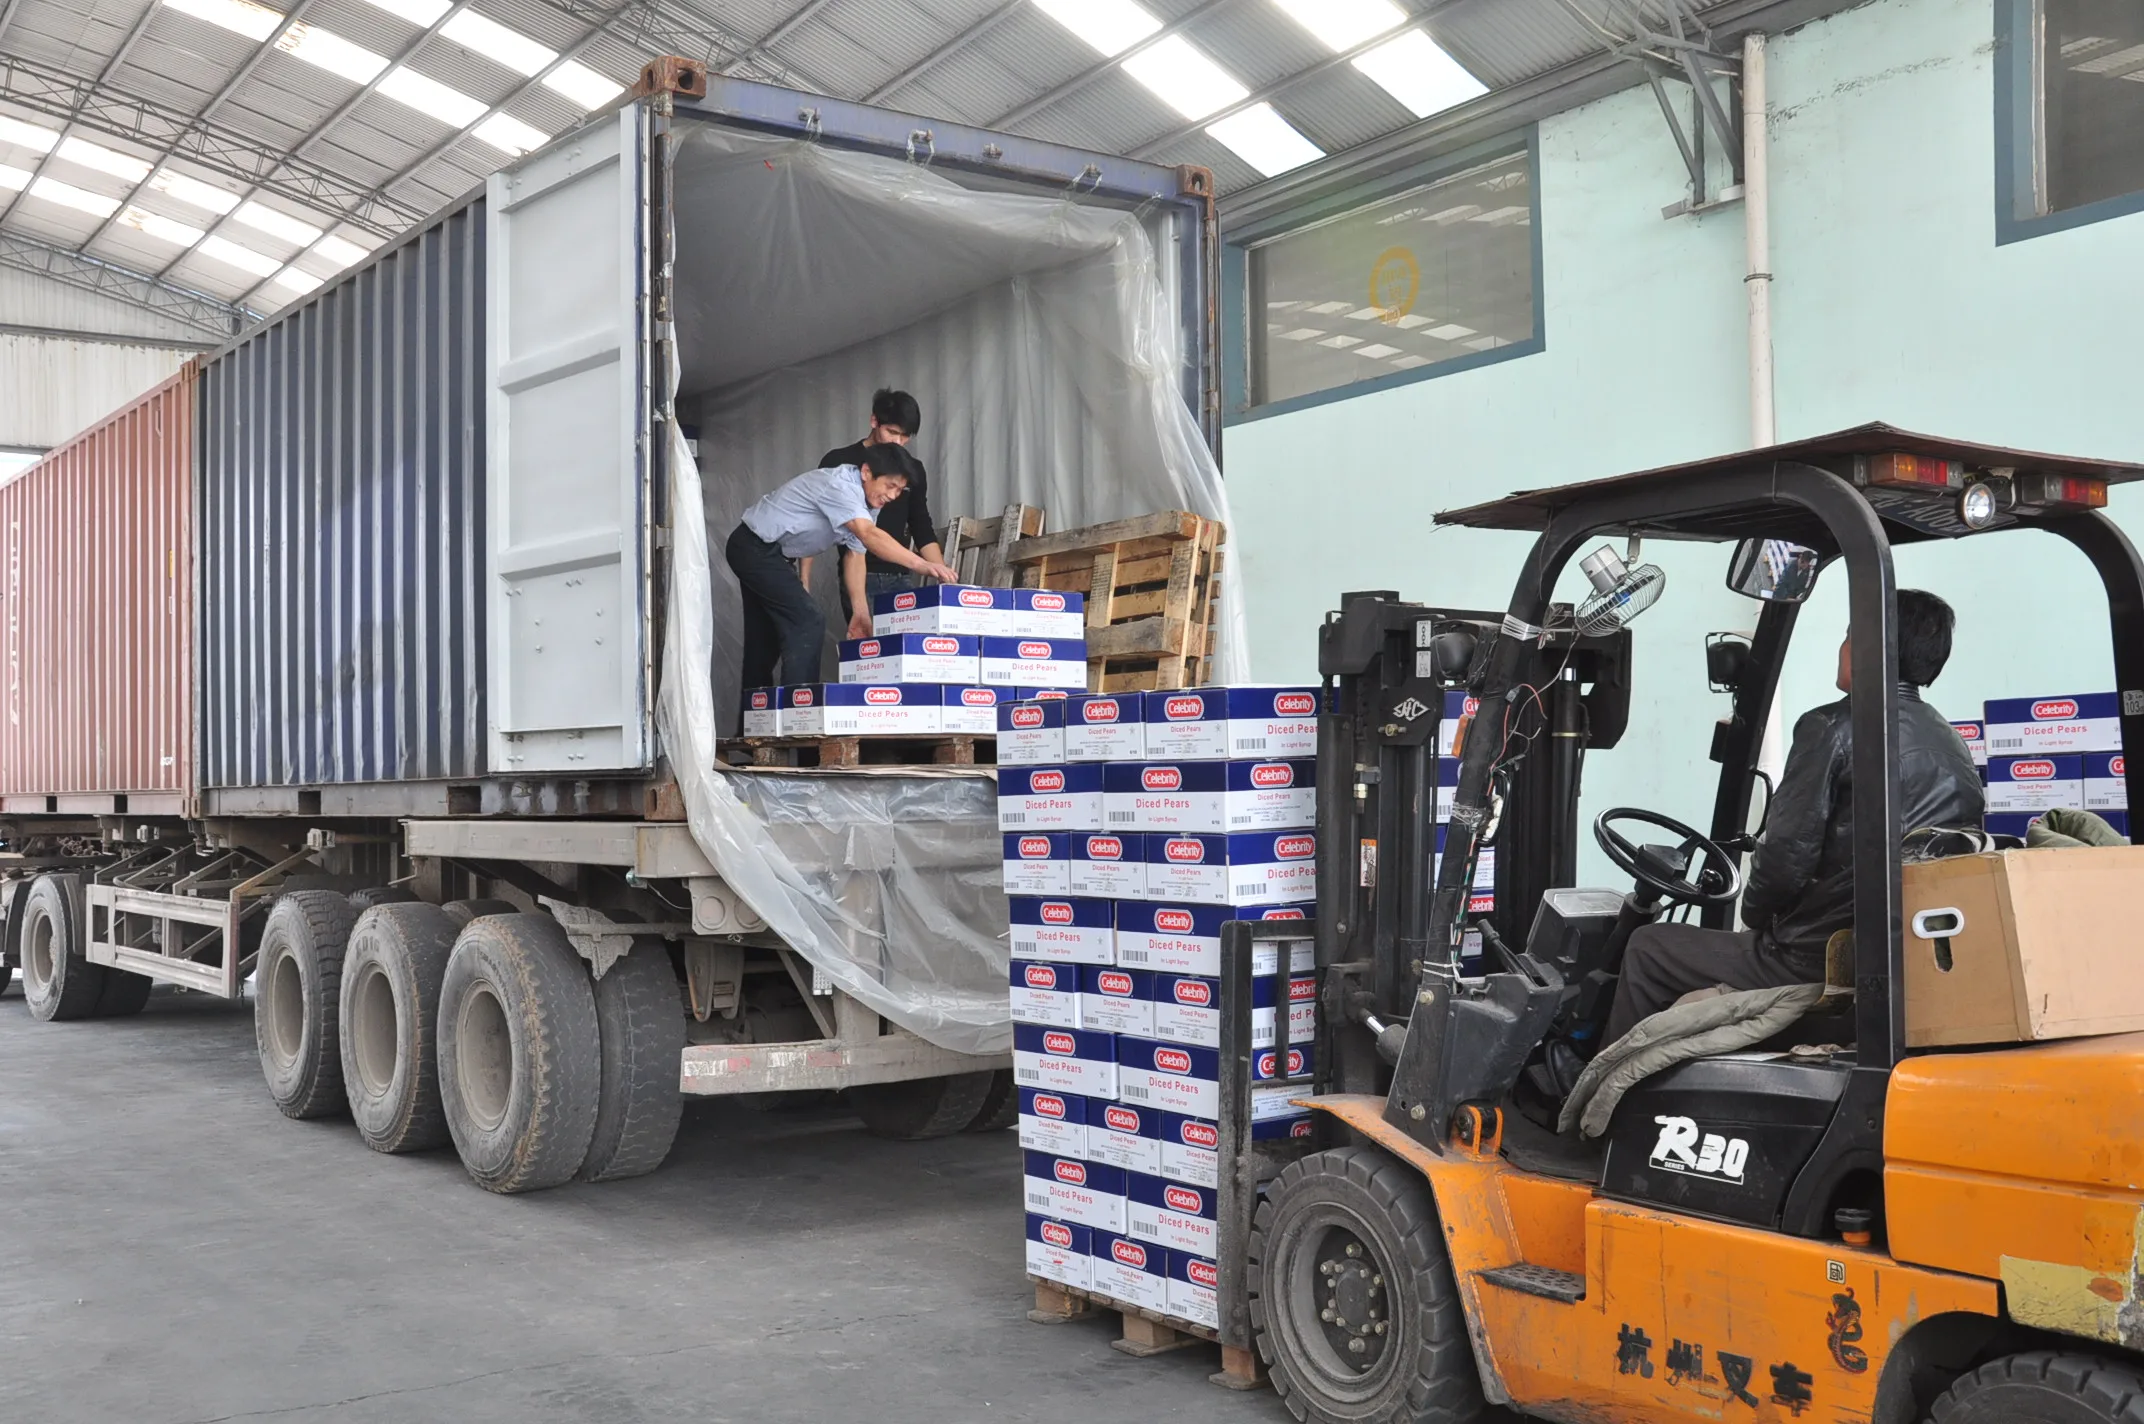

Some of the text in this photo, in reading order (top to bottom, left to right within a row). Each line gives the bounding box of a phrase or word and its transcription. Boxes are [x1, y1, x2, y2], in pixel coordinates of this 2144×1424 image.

[897, 596, 914, 607] Celebrity
[961, 594, 992, 605] Celebrity
[1034, 597, 1063, 609] Celebrity
[862, 644, 878, 654] Celebrity
[926, 640, 958, 653] Celebrity
[1020, 645, 1051, 657] Celebrity
[796, 693, 810, 702] Celebrity
[867, 690, 900, 703] Celebrity
[964, 692, 993, 704] Celebrity
[1168, 699, 1201, 714] Celebrity
[1278, 698, 1312, 711] Celebrity
[2036, 704, 2074, 716] Celebrity
[1014, 709, 1041, 723] Celebrity
[1086, 705, 1116, 719] Celebrity
[1268, 724, 1318, 734] Diced Pear
[2024, 726, 2087, 735] Diced Pears
[1255, 769, 1289, 782] Celebrity
[2014, 764, 2051, 775] Celebrity
[1034, 775, 1062, 788] Celebrity
[1145, 772, 1178, 785] Celebrity
[1025, 799, 1072, 810] Diced Pears
[1136, 798, 1190, 808] Diced Pears
[1023, 841, 1048, 854] Celebrity
[1090, 841, 1119, 855] Celebrity
[1168, 843, 1201, 858] Celebrity
[1278, 841, 1313, 854] Celebrity
[1268, 866, 1316, 878] Diced Pea
[1044, 907, 1070, 920] Celebrity
[1158, 914, 1190, 929] Celebrity
[1036, 931, 1081, 942] Diced Pears
[1149, 939, 1201, 952] Diced Pears
[1029, 970, 1053, 984] Celebrity
[1102, 976, 1130, 992] Celebrity
[1178, 984, 1207, 1001] Celebrity
[1103, 999, 1130, 1009] Diced Pears
[1179, 1008, 1208, 1019] Diced Pears
[1047, 1036, 1072, 1051] Celebrity
[1039, 1059, 1082, 1074] Diced Pears
[1158, 1052, 1188, 1069] Celebrity
[1149, 1076, 1199, 1094] Diced Pears
[1036, 1098, 1062, 1114] Celebrity
[1108, 1111, 1137, 1128] Celebrity
[1051, 1122, 1063, 1131] Pears
[1110, 1134, 1137, 1146] Diced Pears
[1184, 1125, 1216, 1144] Celebrity
[1186, 1150, 1216, 1162] Diced Pears
[1057, 1164, 1083, 1181] Celebrity
[1663, 1161, 1685, 1171] SERIES
[1050, 1186, 1093, 1204] Diced Pears
[1168, 1190, 1199, 1209] Celebrity
[1158, 1214, 1210, 1236] Diced Pears
[1044, 1226, 1069, 1244] Celebrity
[1046, 1248, 1070, 1261] Diced Pears
[1115, 1244, 1143, 1264] Celebrity
[1117, 1267, 1144, 1281] Diced Pears
[1193, 1288, 1206, 1298] Diced
